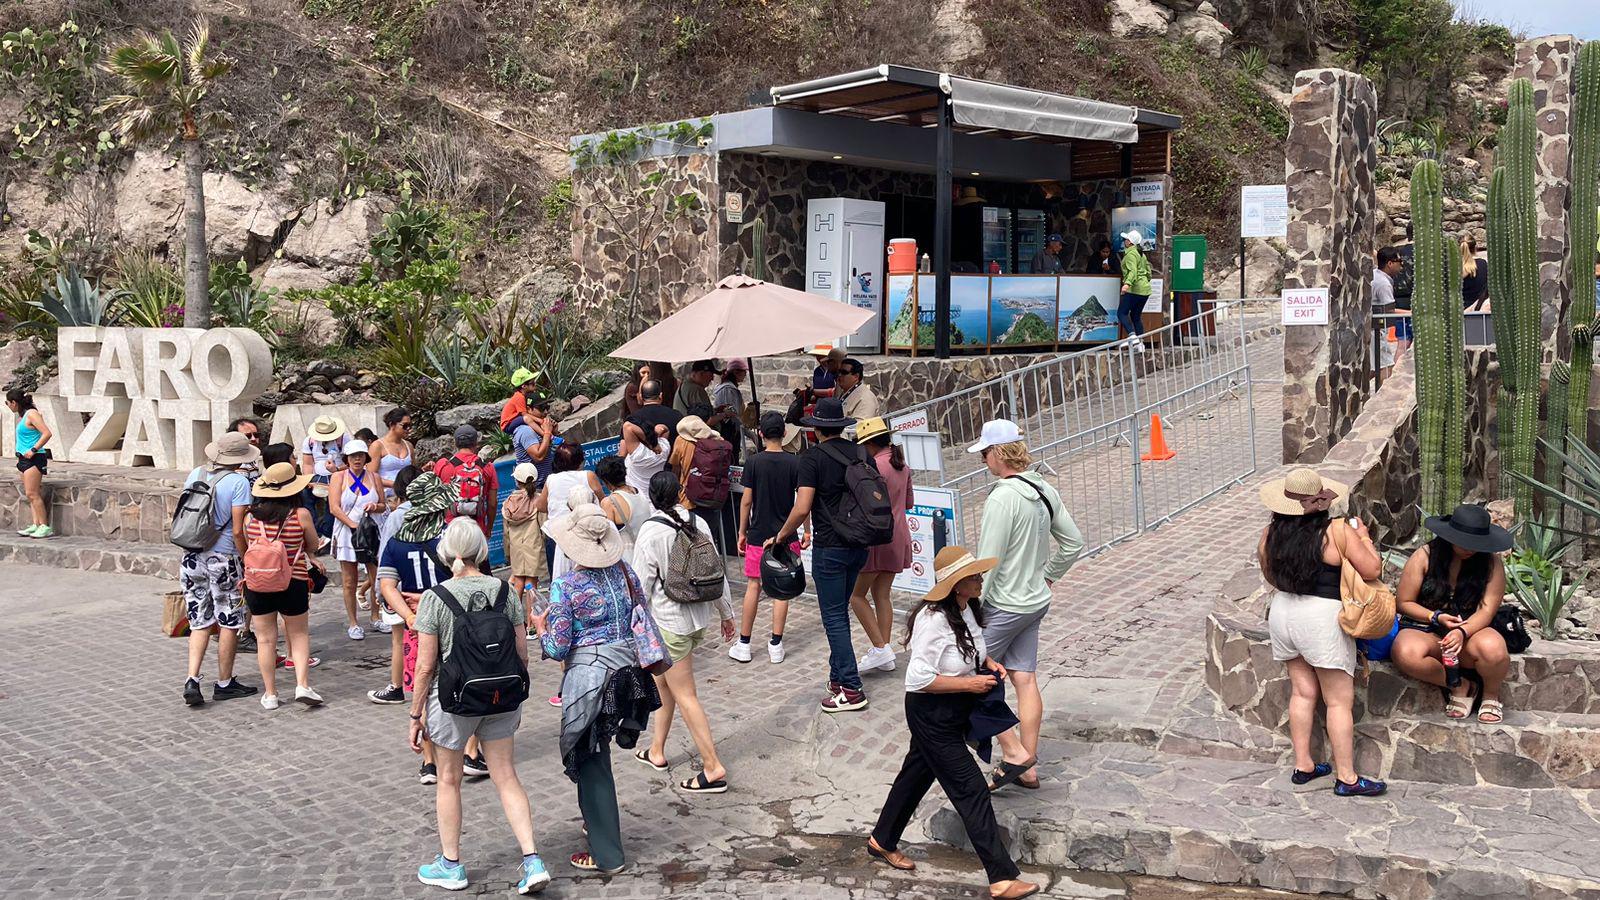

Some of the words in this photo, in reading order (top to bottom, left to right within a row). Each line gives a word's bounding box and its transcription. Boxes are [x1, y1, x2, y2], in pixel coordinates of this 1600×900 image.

[1133, 184, 1161, 192] ENTRADA
[813, 214, 834, 289] HIE
[1287, 296, 1323, 305] SALIDA
[1294, 308, 1316, 318] EXIT
[58, 326, 250, 401] FARO
[408, 551, 438, 589] 11
